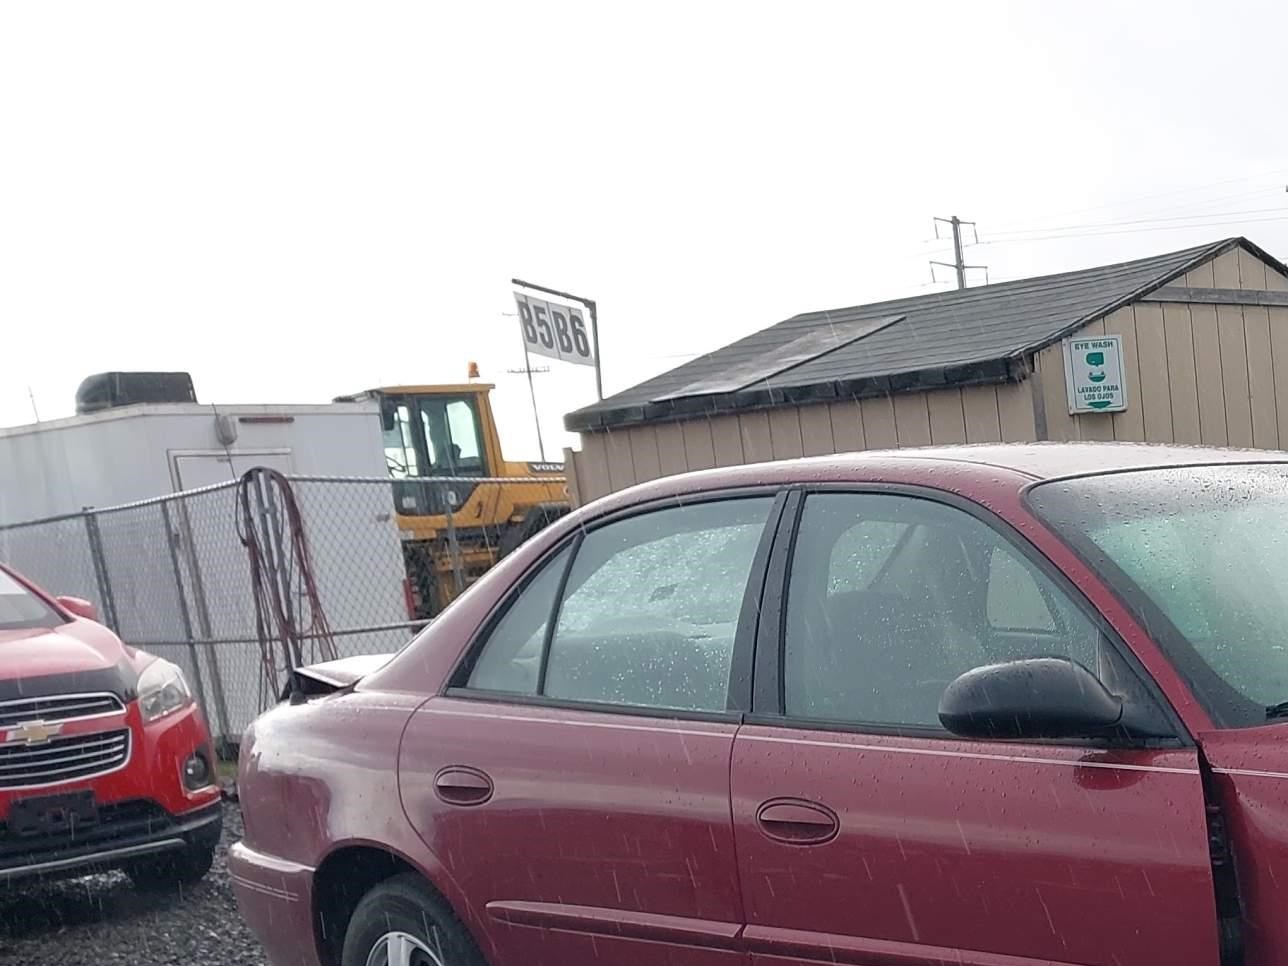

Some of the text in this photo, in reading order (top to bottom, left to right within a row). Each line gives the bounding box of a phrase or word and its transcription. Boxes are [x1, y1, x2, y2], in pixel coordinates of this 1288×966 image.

[1074, 340, 1114, 351] EYE WASH
[1077, 384, 1120, 394] LAVADO PARA
[1083, 392, 1115, 401] LOS OJOS
[531, 463, 565, 472] VOLV
